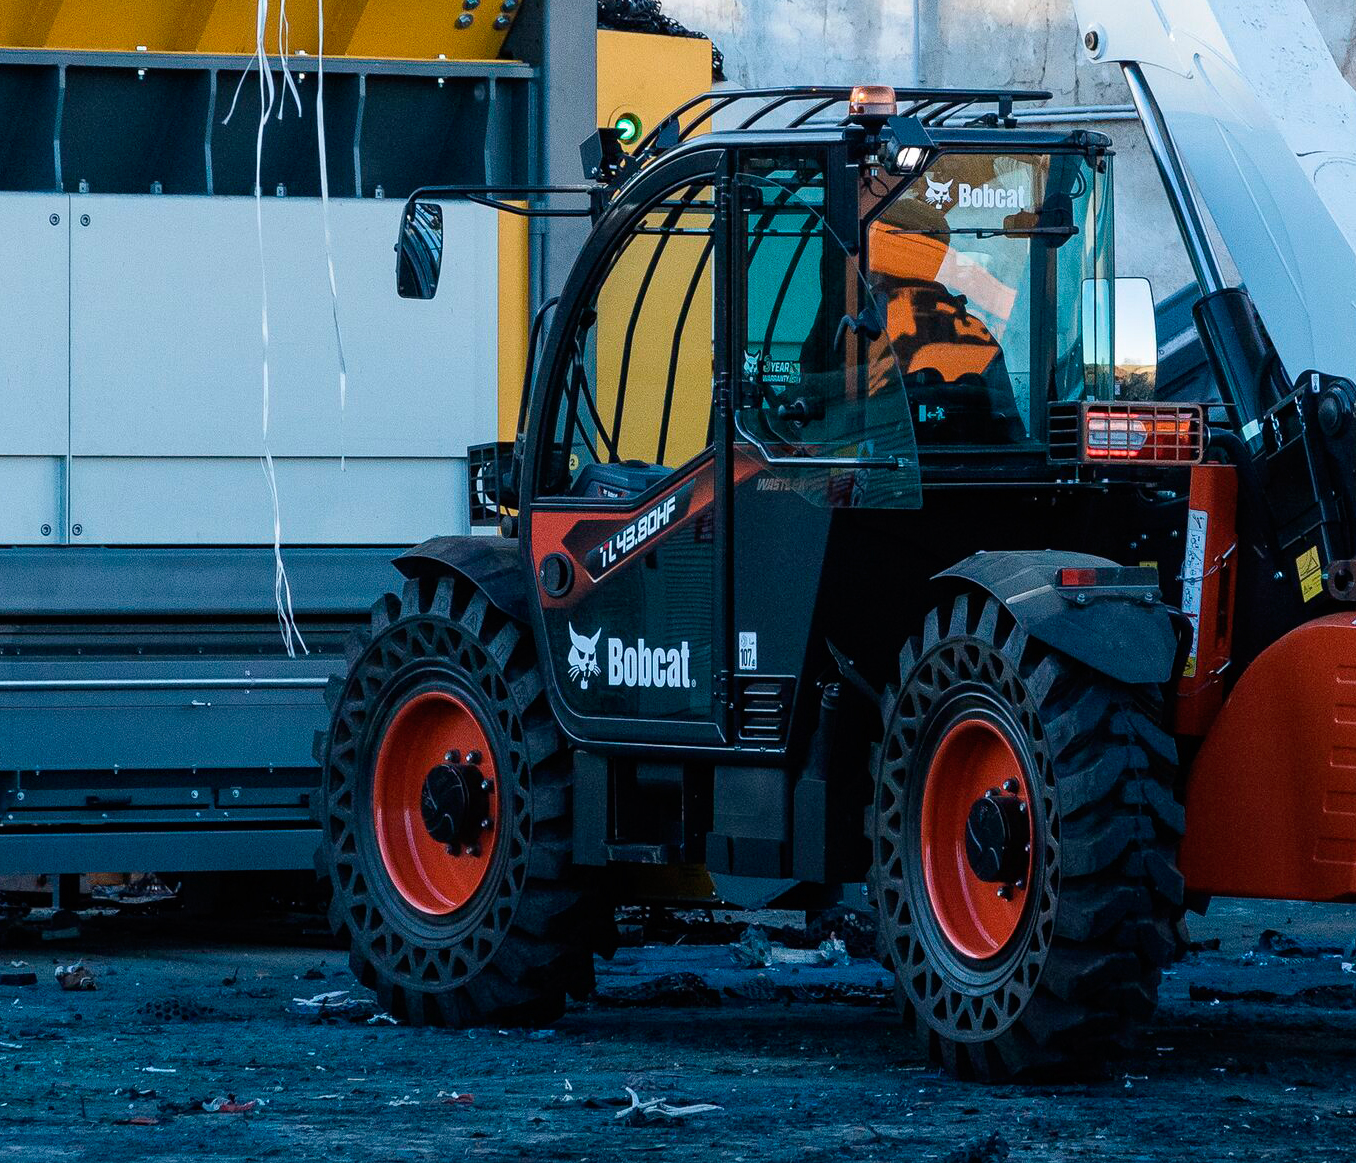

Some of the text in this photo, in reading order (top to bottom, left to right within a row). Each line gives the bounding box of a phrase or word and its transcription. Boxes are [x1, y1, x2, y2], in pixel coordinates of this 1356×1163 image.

[958, 183, 1025, 208] Bobcat
[771, 362, 790, 372] YEAR
[607, 637, 691, 689] Bobcat
